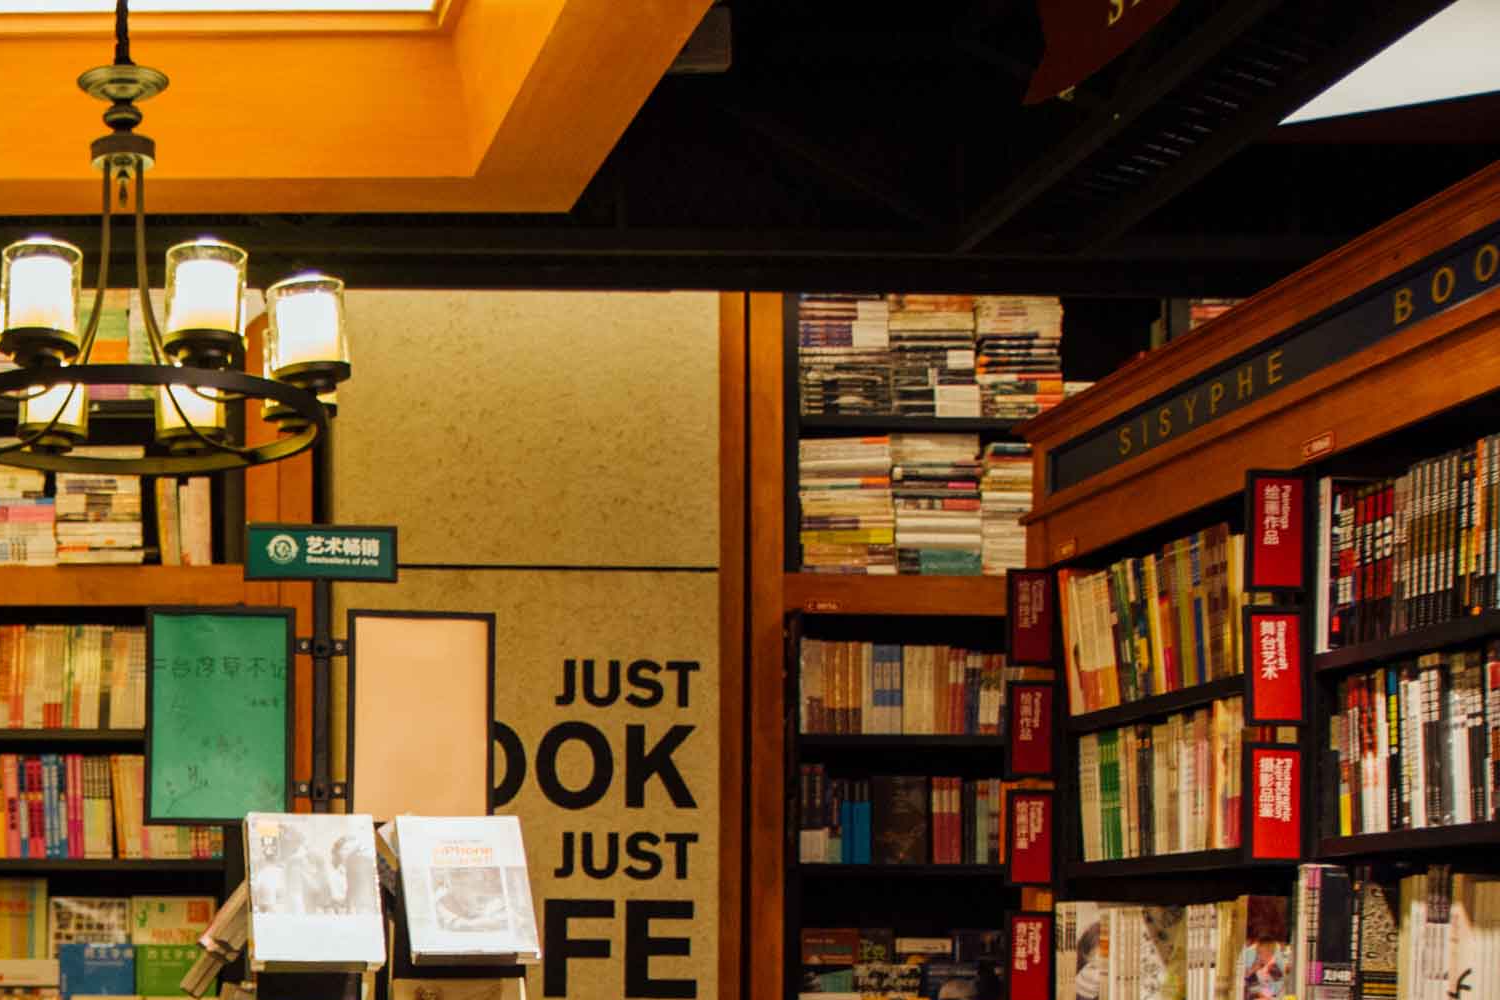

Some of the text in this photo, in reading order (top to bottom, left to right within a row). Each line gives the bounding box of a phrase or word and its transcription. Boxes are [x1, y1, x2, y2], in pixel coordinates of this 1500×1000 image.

[1117, 350, 1285, 457] SISYPHE
[555, 658, 702, 708] JUST
[553, 830, 698, 880] JUST
[543, 898, 696, 998] FE
